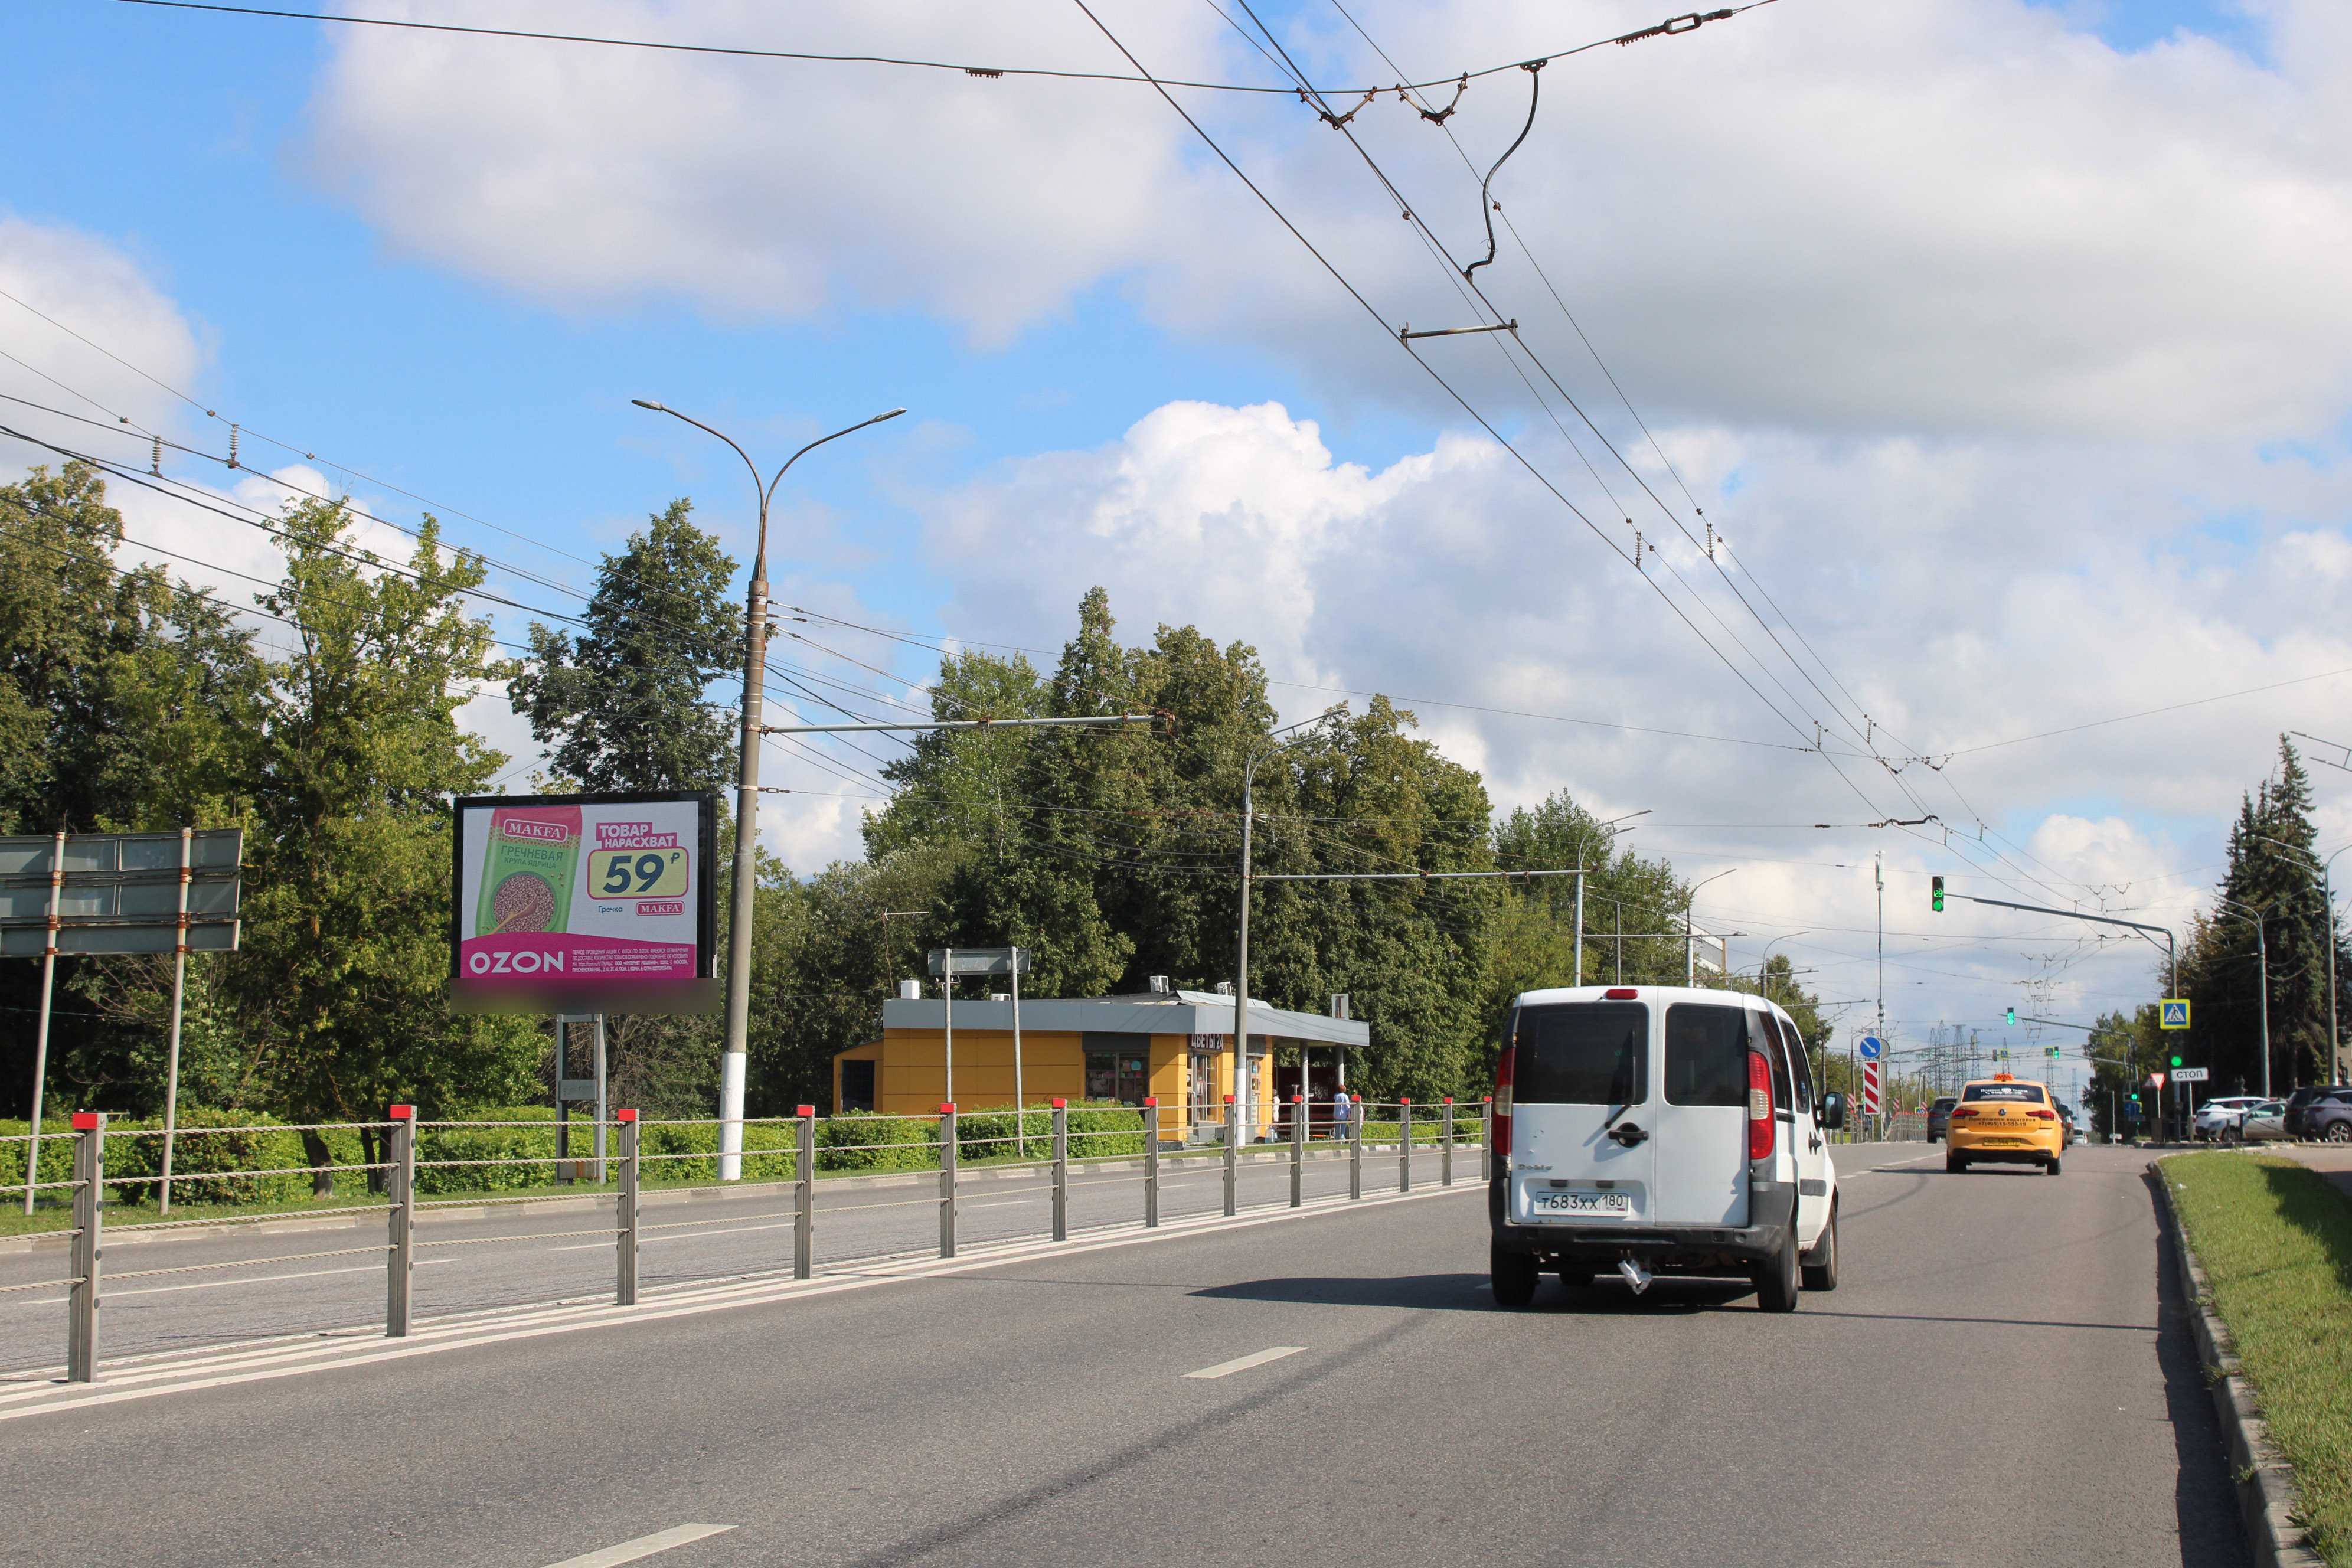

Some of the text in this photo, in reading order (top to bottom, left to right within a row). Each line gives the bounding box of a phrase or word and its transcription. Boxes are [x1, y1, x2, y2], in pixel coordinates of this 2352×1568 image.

[509, 822, 561, 838] MAKFA
[599, 824, 648, 838] ТОВАР
[605, 836, 675, 848] НАРАСХВАТ
[501, 845, 563, 861] ГРЕЧНЕВАЯ
[505, 857, 557, 870] КРУПА ЯДРИЦА
[603, 854, 664, 894] 59
[598, 906, 623, 914] Гречка
[641, 904, 680, 913] MAKFA
[469, 950, 564, 974] OZON
[1191, 1034, 1223, 1050] ЦВЕТЫ 24
[1602, 1195, 1623, 1206] 180
